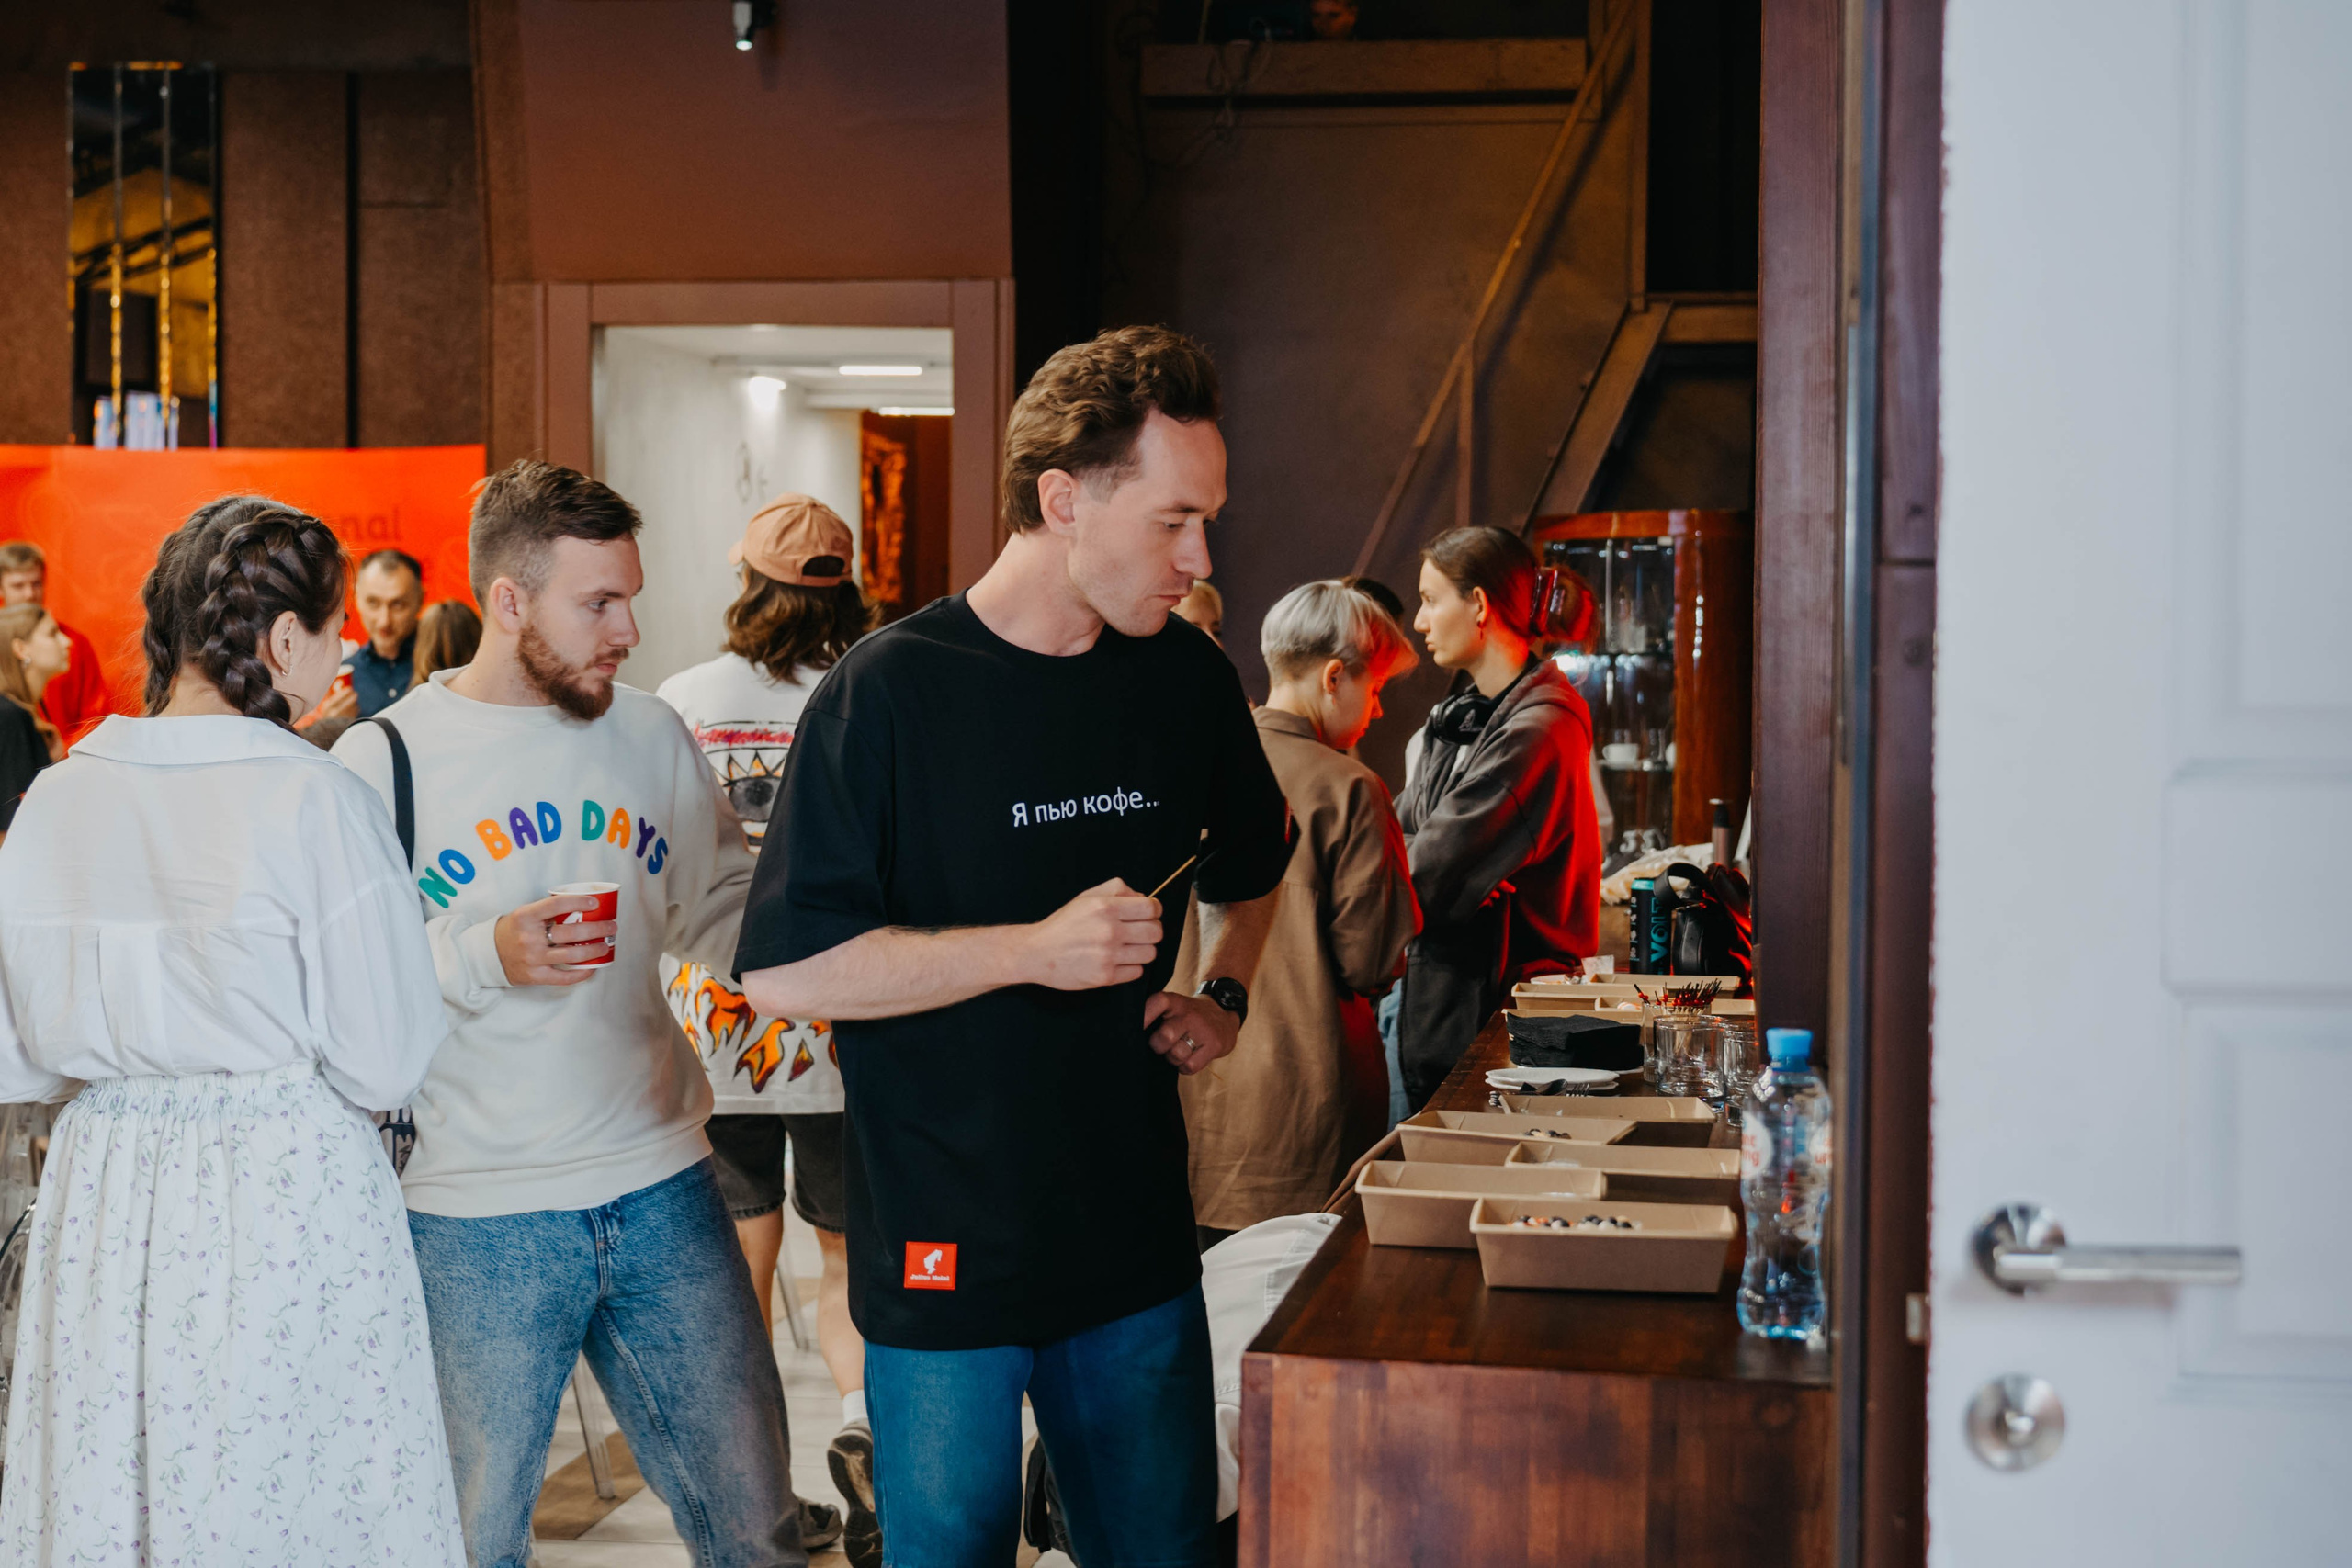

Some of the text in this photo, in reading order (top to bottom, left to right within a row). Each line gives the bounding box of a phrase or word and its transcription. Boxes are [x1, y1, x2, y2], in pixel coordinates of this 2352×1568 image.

[1012, 802, 1028, 828] Я
[1035, 799, 1077, 823] пью
[418, 800, 668, 908] NO BAD DAYS
